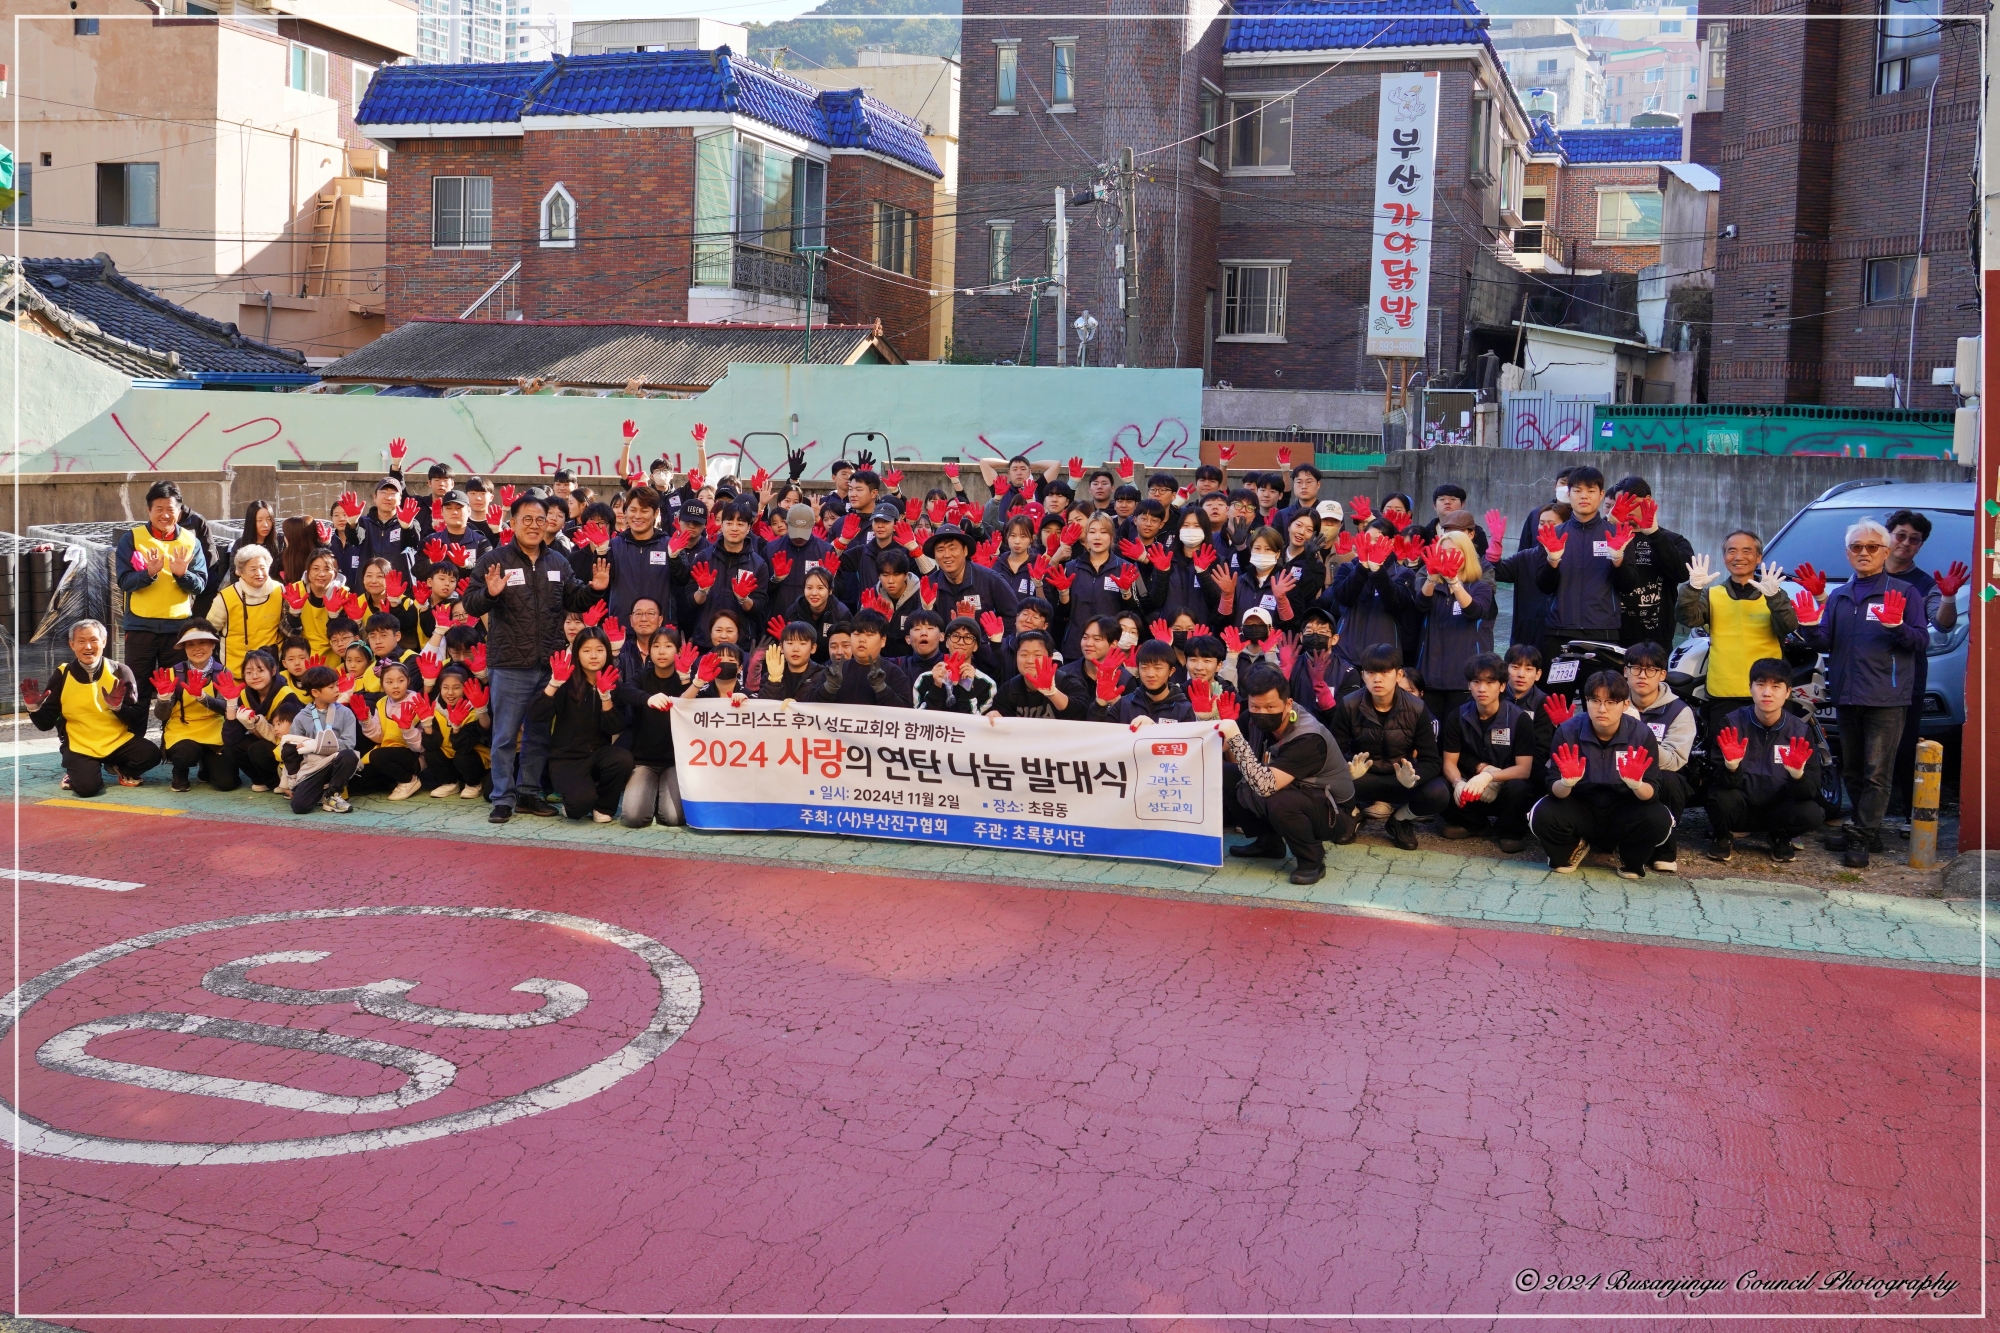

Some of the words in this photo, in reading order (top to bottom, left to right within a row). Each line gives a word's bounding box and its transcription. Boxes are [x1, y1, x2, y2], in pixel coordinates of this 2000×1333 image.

[1370, 340, 1419, 353] T.893-8800
[693, 711, 788, 729] 예수그리스도
[791, 713, 822, 731] 후기
[824, 716, 900, 738] 성도교회와
[904, 721, 967, 744] 함께하는
[1156, 743, 1184, 756] 후원
[688, 738, 769, 768] 2024
[777, 737, 872, 779] 사랑의
[877, 746, 943, 784] 연탄
[947, 752, 1016, 792] 나눔
[1020, 756, 1128, 799] 발대식
[1159, 762, 1180, 774] 예수
[1147, 775, 1192, 786] 그리스도
[820, 785, 850, 801] 일시:
[853, 788, 904, 805] 2024년
[907, 792, 934, 808] 11월
[937, 794, 960, 810] 2일
[1158, 788, 1182, 800] 후기
[993, 798, 1024, 814] 장소:
[1028, 800, 1069, 819] 초읍동
[1147, 801, 1193, 815] 성도교회
[800, 809, 833, 826] 주최:
[837, 810, 949, 836] (사)부산진구협회
[973, 821, 1008, 840] 주관:
[1011, 825, 1086, 848] 초록봉사단
